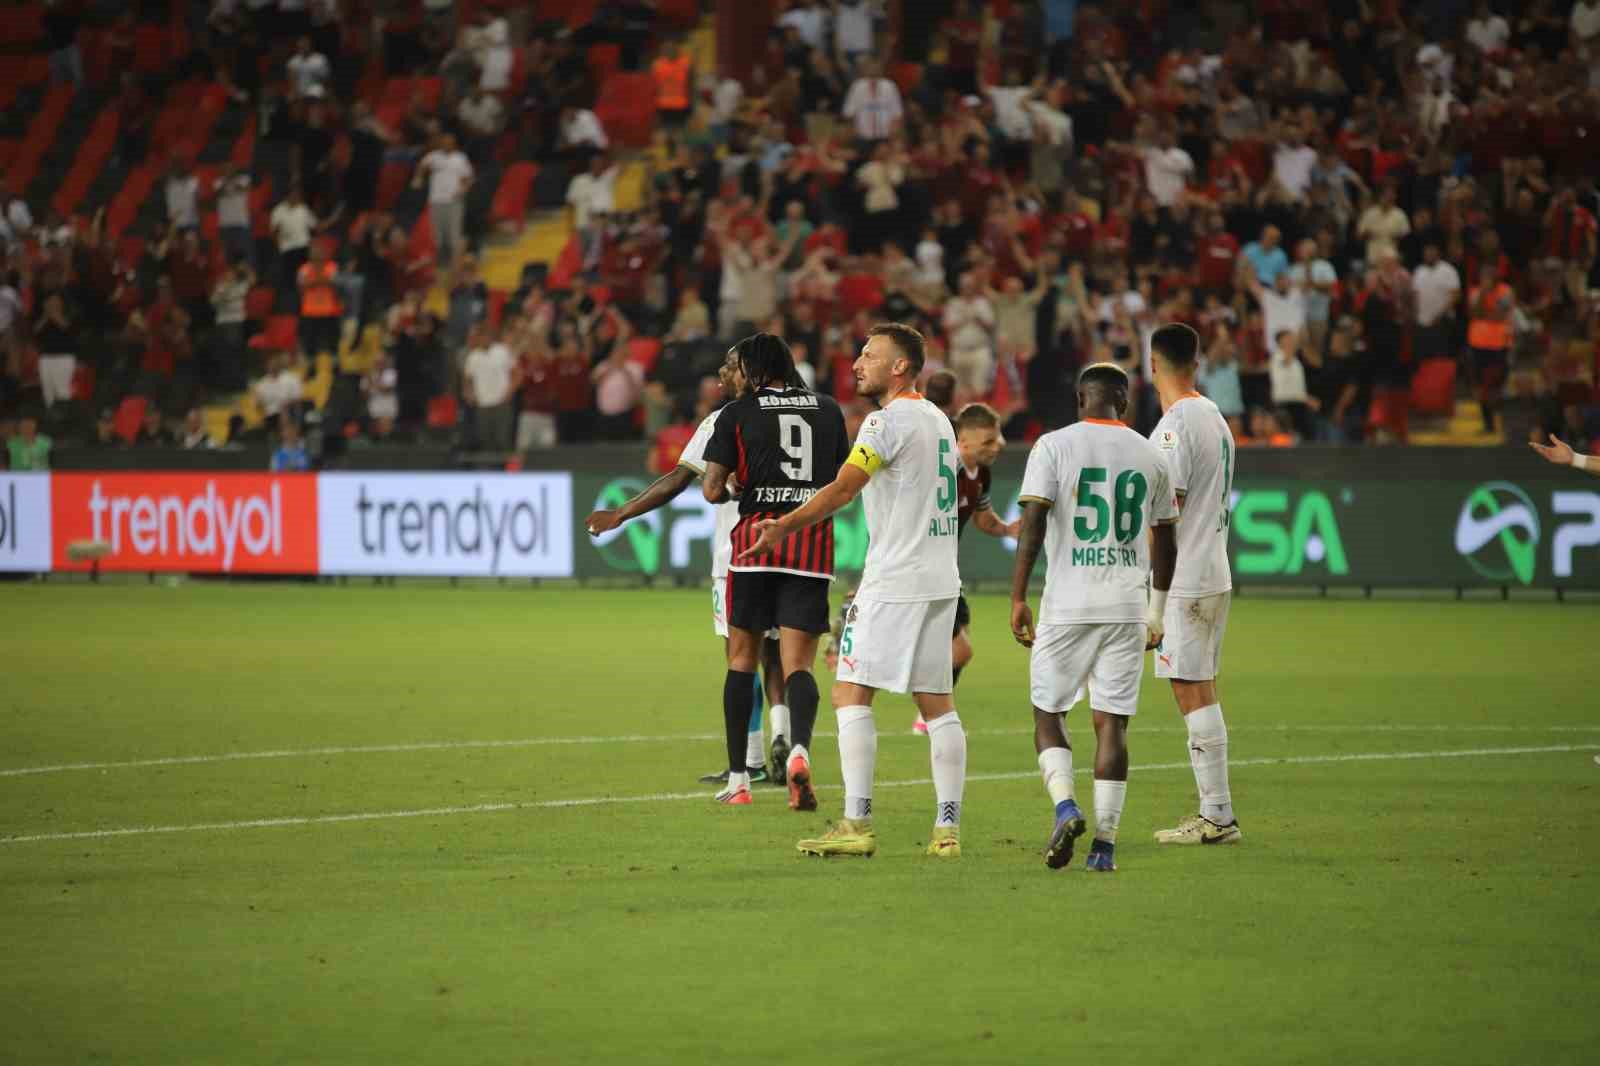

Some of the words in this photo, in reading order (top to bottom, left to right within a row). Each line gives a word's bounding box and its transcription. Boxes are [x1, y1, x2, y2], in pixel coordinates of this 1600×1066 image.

[777, 414, 813, 481] 9
[936, 438, 957, 512] 5
[89, 479, 281, 571] trendyol
[356, 484, 549, 575] trendyol
[1073, 467, 1147, 544] 58
[842, 626, 853, 656] 5
